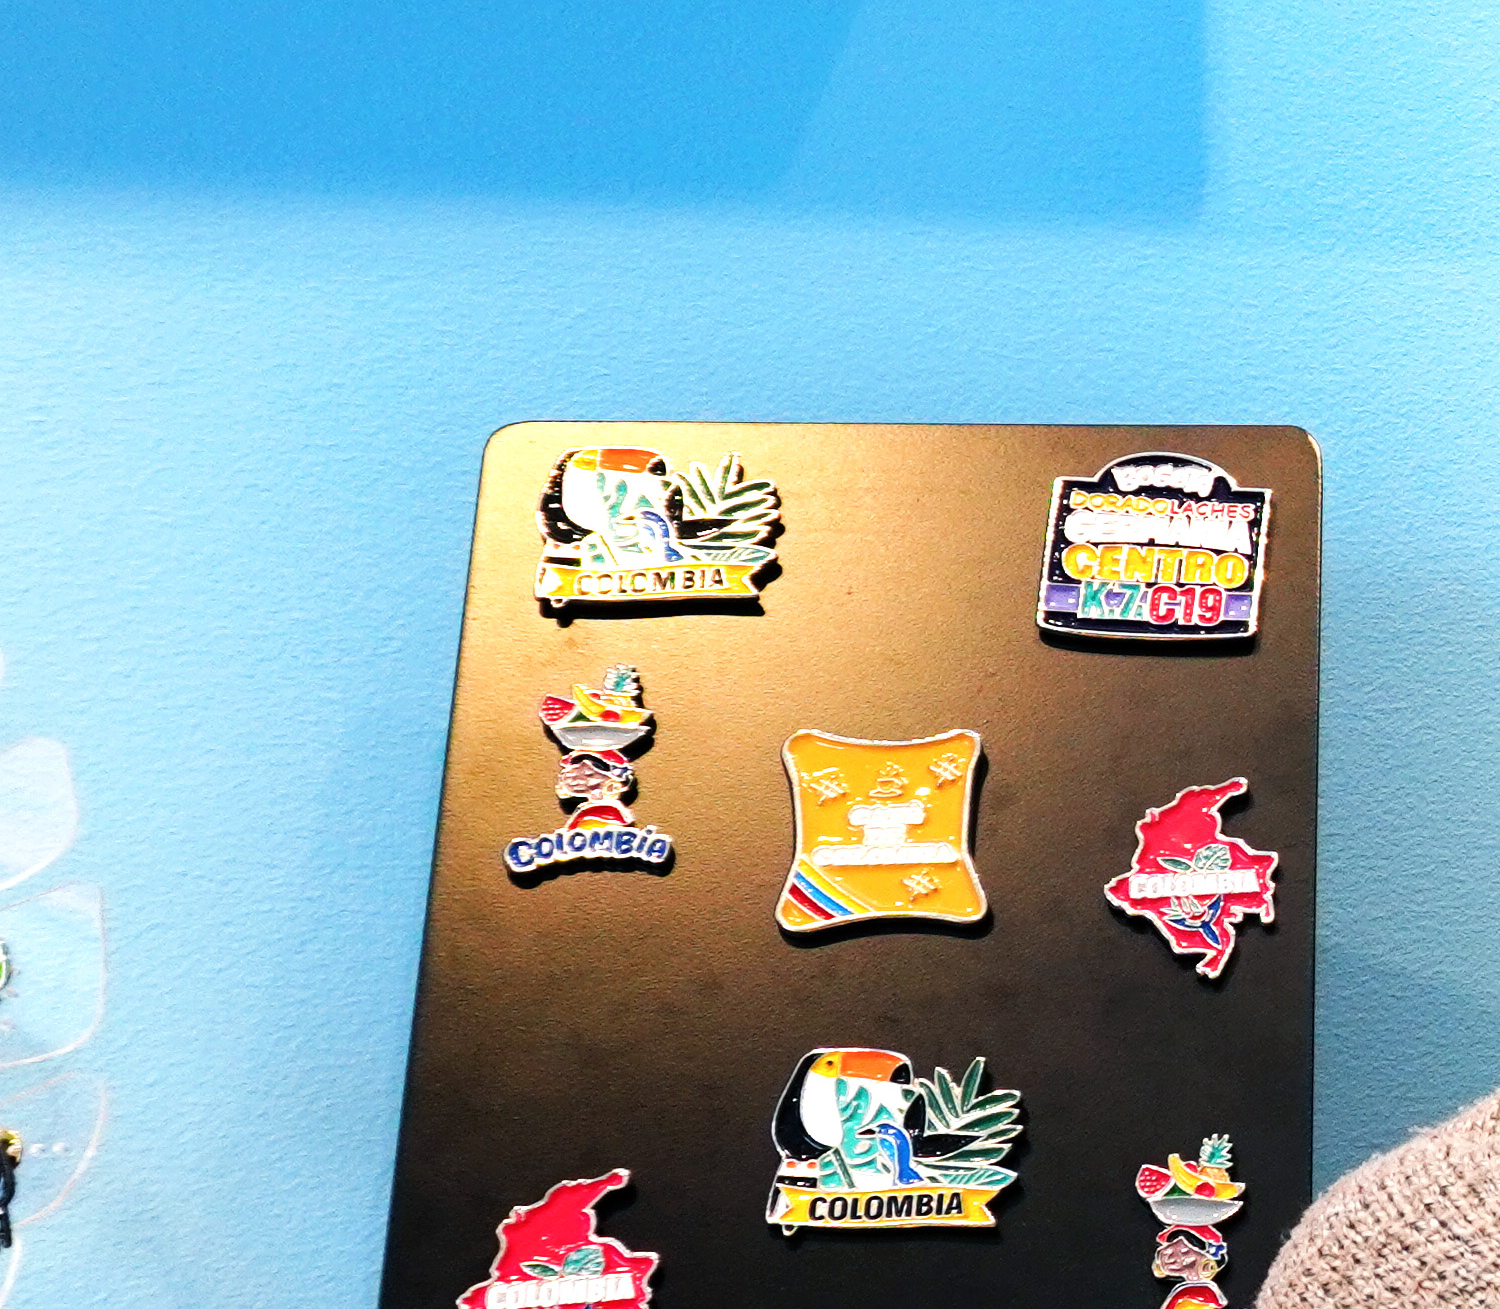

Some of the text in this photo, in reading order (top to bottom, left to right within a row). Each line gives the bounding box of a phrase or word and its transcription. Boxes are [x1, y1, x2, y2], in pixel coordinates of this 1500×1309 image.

[1062, 543, 1248, 589] CENTRO
[575, 567, 728, 596] COLOMBIA
[808, 1192, 964, 1222] COLOMBIA
